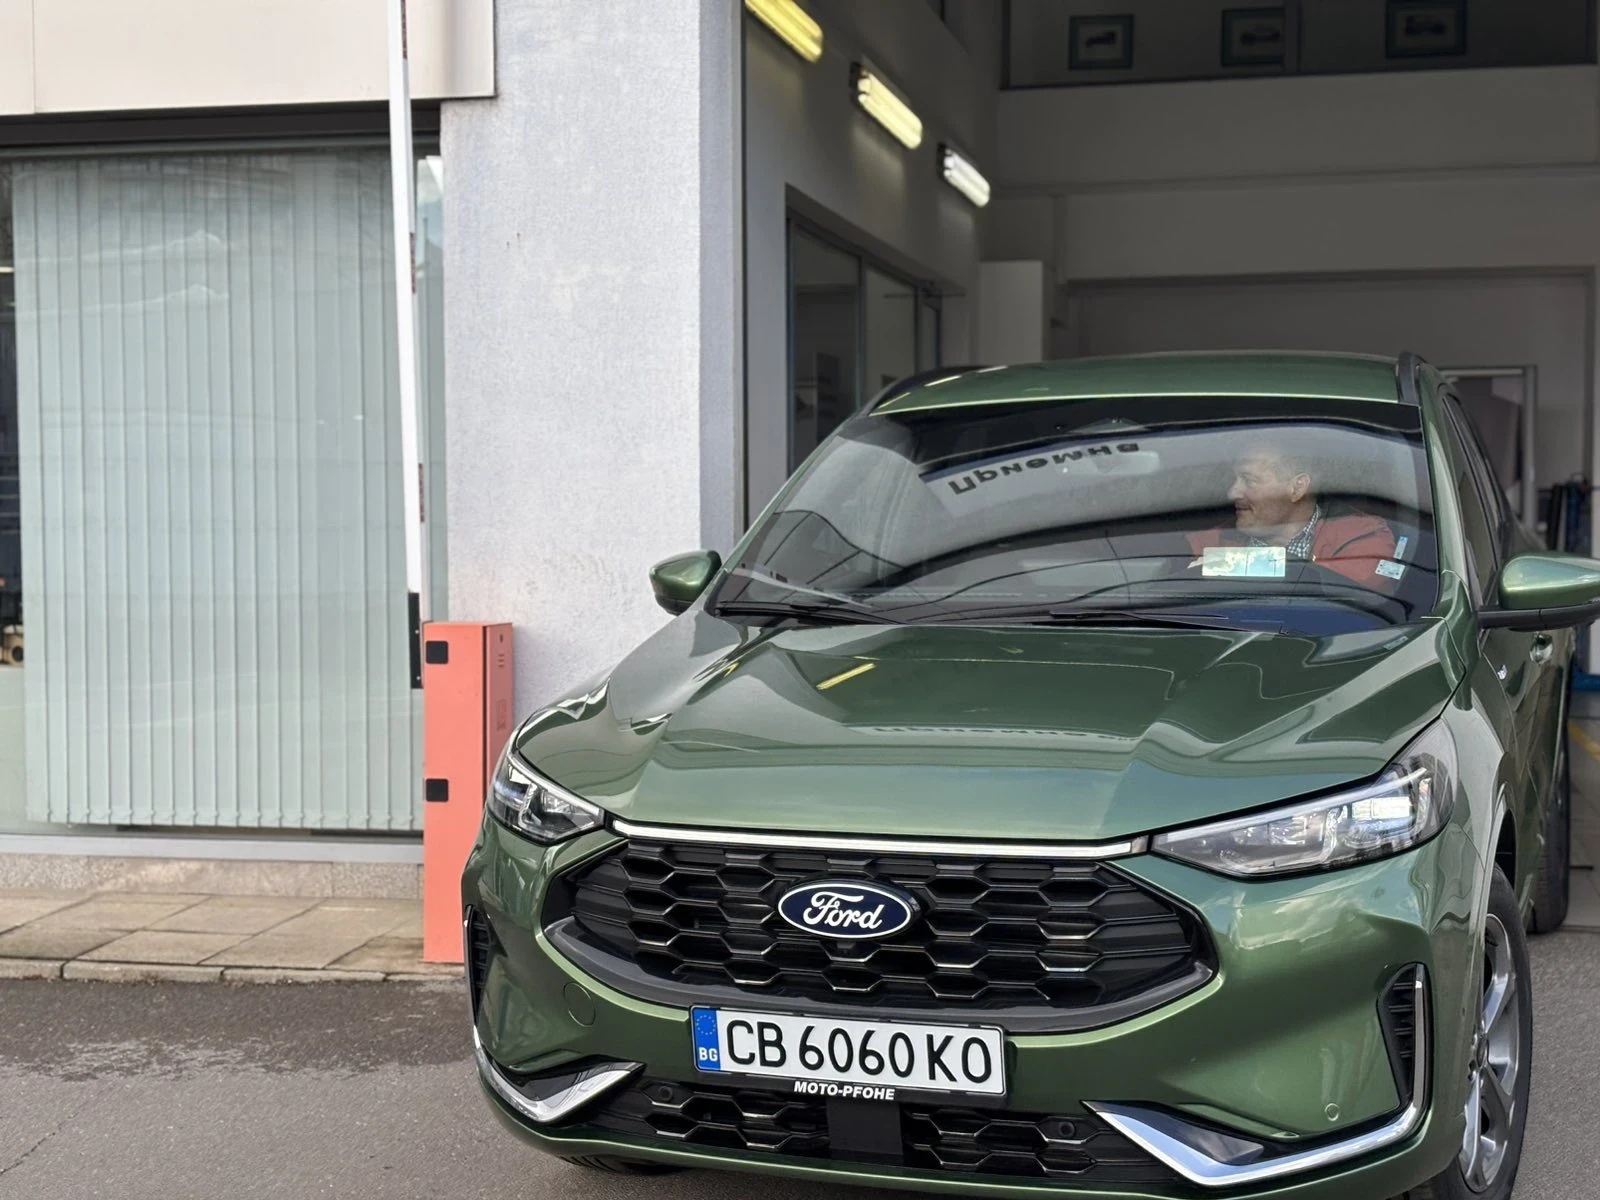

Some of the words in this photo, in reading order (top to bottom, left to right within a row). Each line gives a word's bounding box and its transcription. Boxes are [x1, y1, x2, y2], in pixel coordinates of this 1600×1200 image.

[803, 891, 885, 929] Ford
[699, 1046, 718, 1062] BG
[726, 1019, 787, 1067] CB
[798, 1025, 915, 1078] 6060
[926, 1033, 992, 1084] KO
[793, 1081, 895, 1100] MOTO-PFOHE
